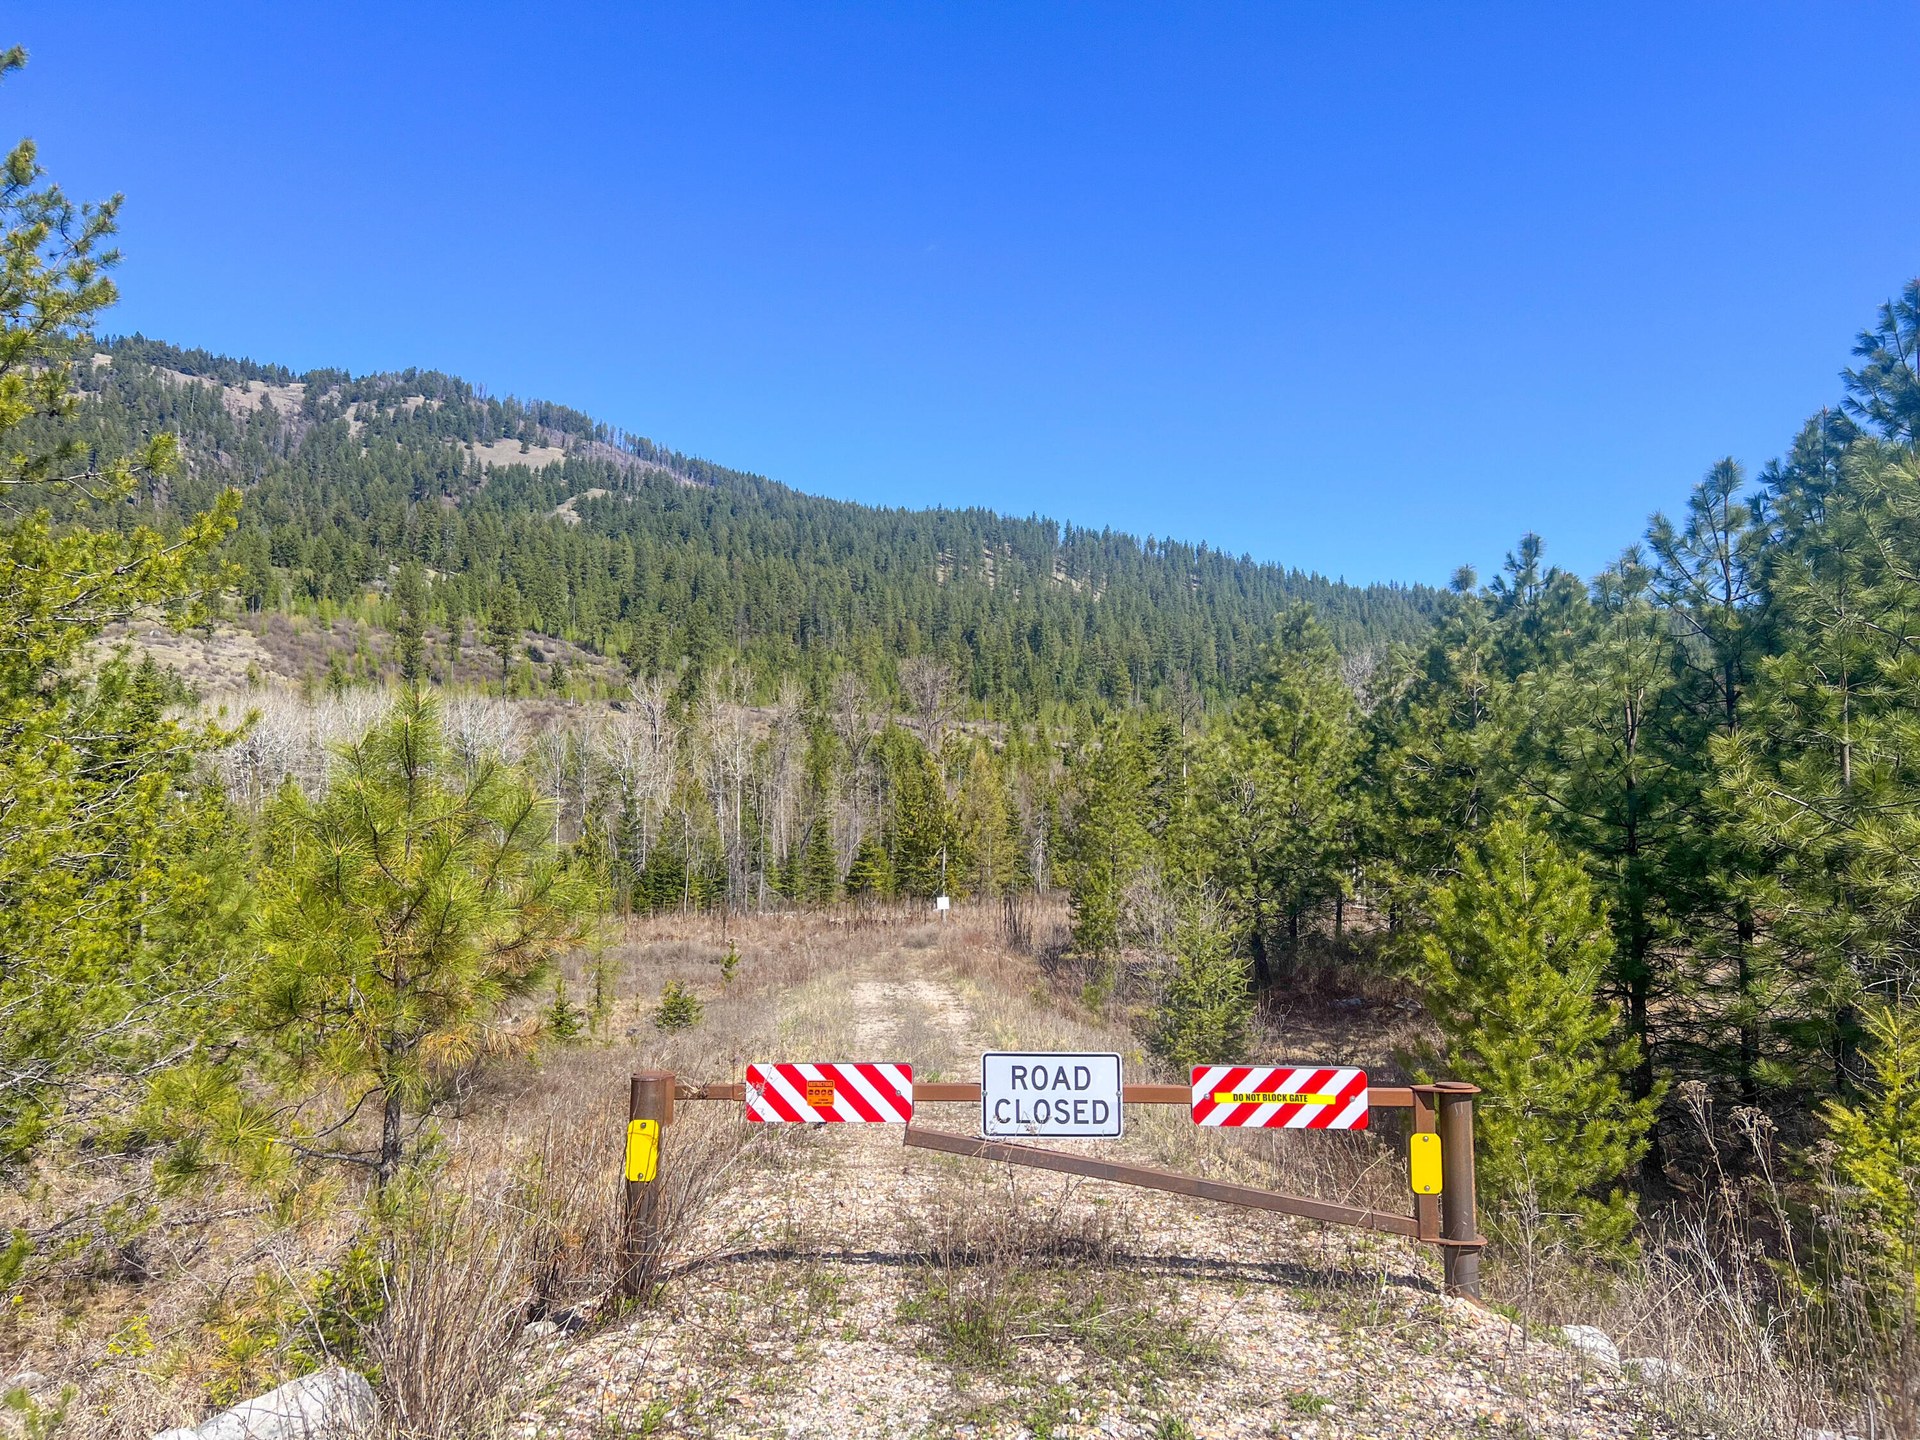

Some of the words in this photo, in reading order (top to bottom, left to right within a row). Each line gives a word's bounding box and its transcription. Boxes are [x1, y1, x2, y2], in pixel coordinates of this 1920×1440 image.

[1011, 1065, 1091, 1091] ROAD
[1233, 1093, 1244, 1102] DO
[1245, 1093, 1260, 1102] NOT
[1262, 1093, 1288, 1102] BLOCK
[1289, 1094, 1308, 1103] GATE
[994, 1098, 1110, 1125] CLOSED
